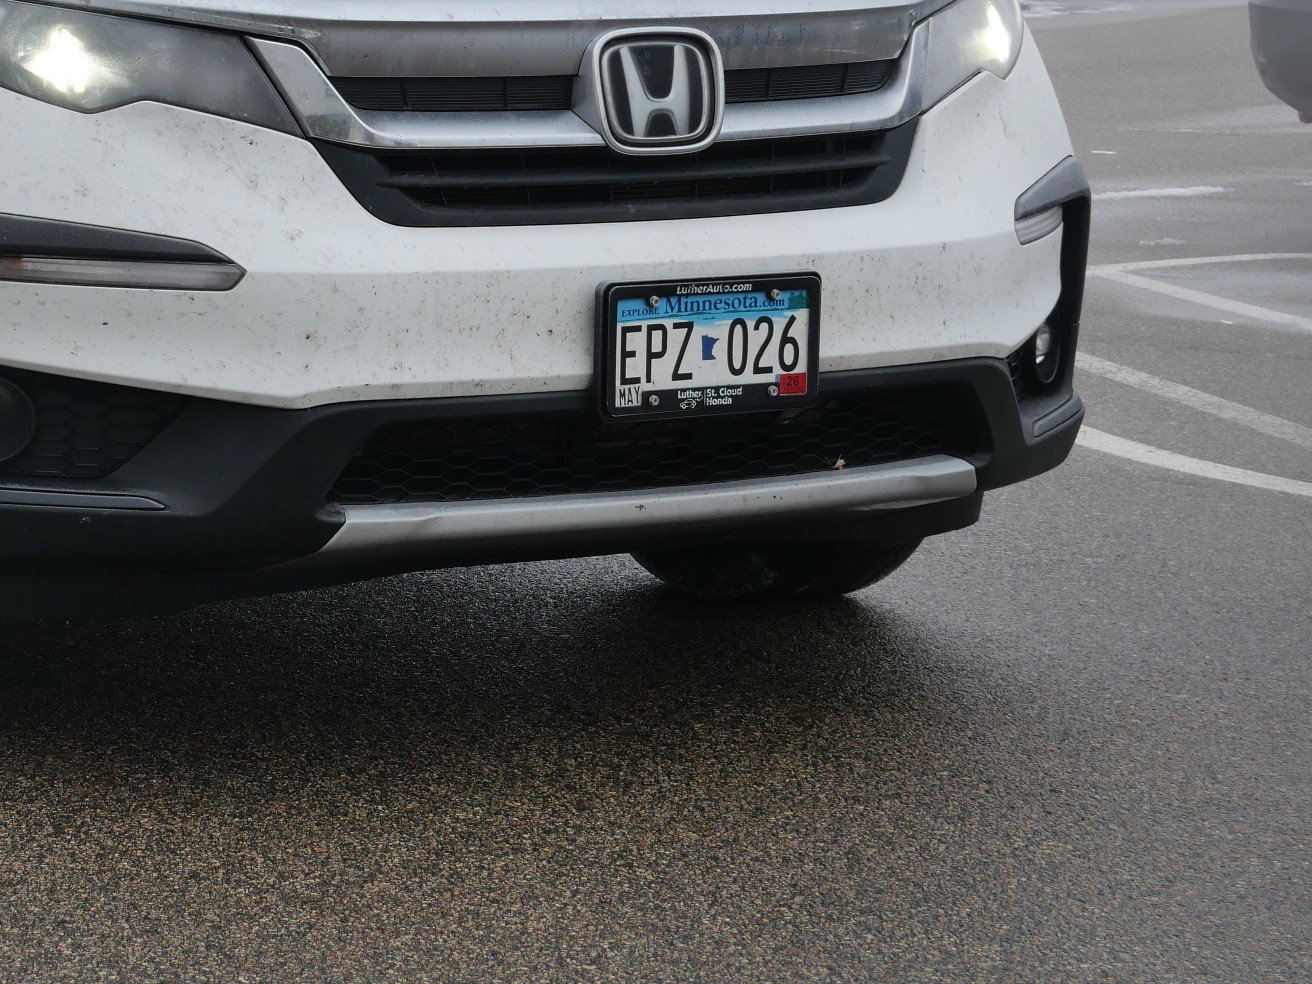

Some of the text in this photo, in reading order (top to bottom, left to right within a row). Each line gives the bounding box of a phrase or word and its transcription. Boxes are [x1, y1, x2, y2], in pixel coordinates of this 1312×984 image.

[621, 307, 660, 318] EXPLORE
[620, 314, 800, 386] EPZ 026
[618, 385, 640, 407] MAY
[677, 390, 702, 399] Luther
[707, 387, 743, 397] St. Cloud
[706, 397, 733, 406] Honda
